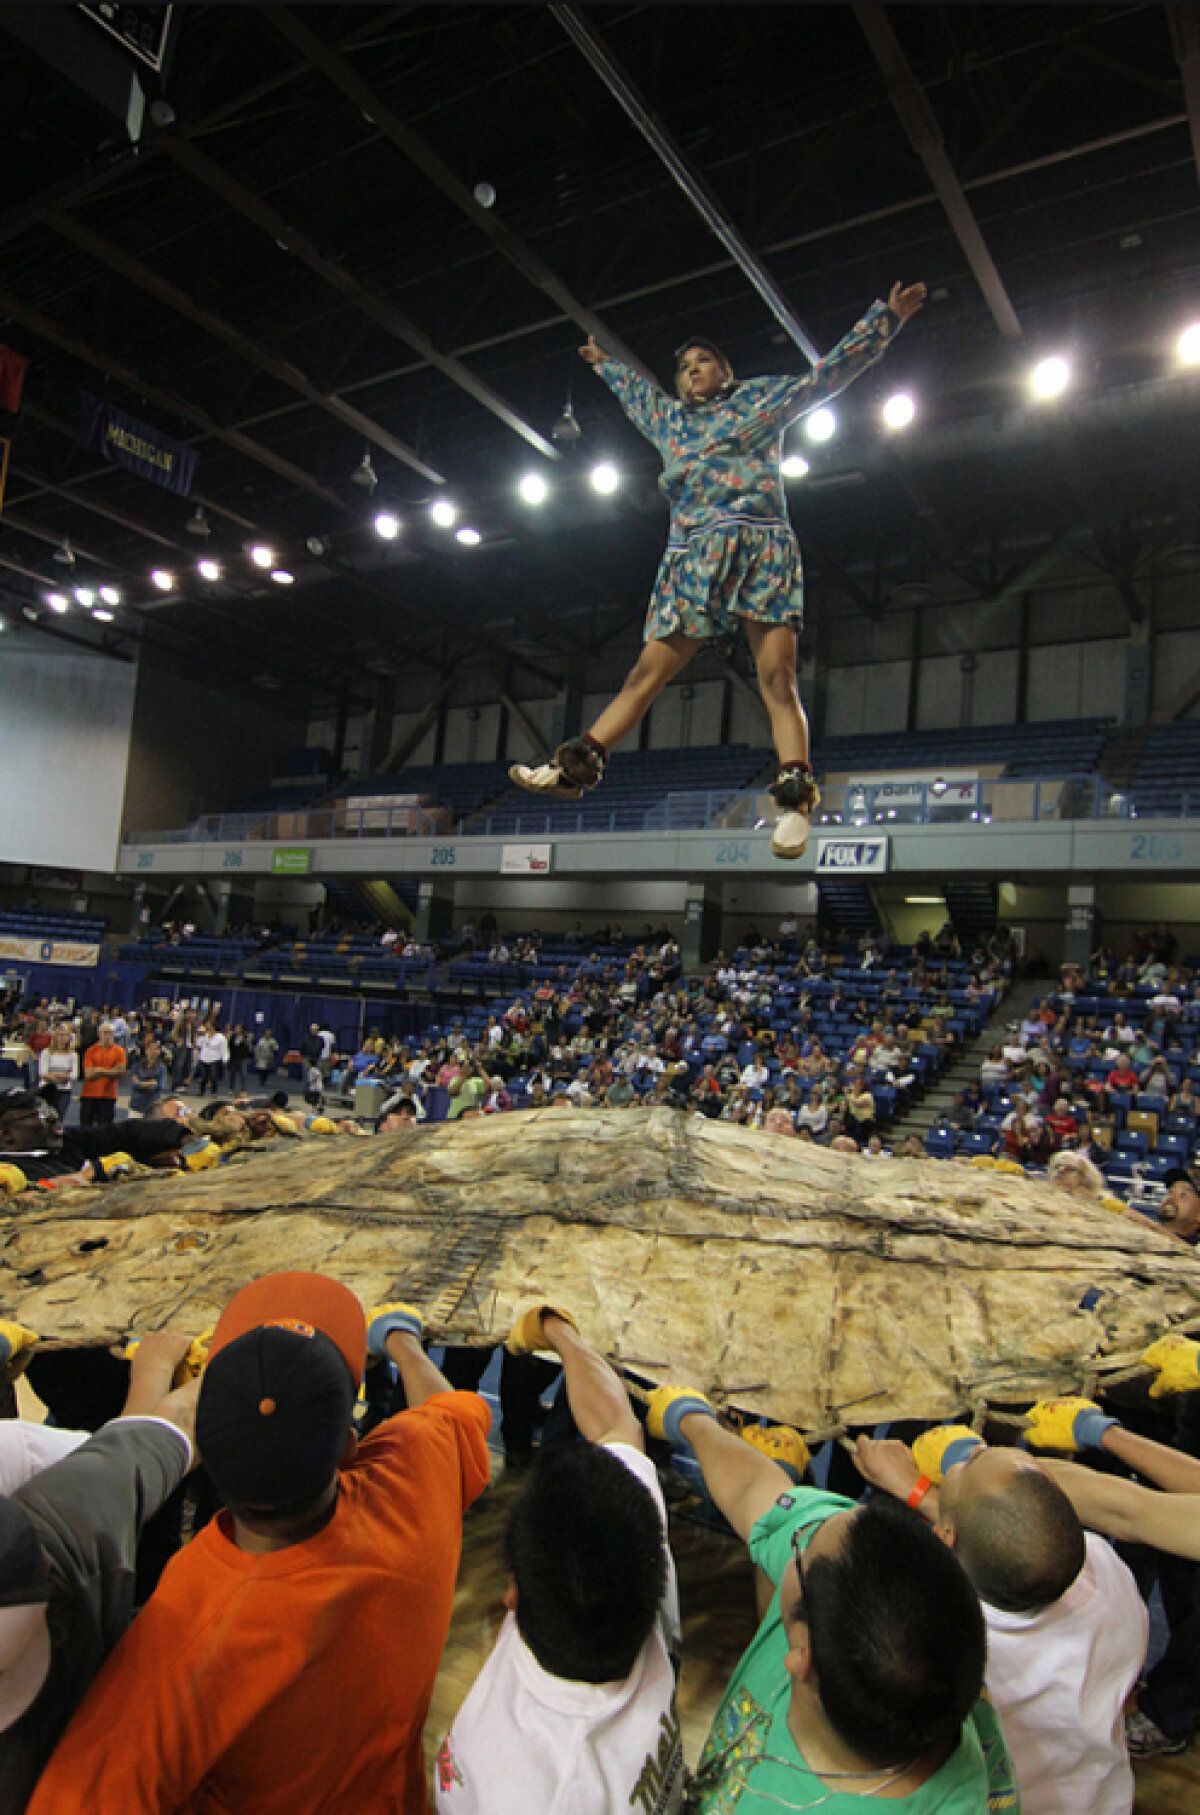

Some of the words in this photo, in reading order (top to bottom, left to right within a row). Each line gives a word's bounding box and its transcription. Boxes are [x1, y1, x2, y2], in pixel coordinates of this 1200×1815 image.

[106, 422, 173, 473] MICHIGAN
[430, 846, 456, 866] 205
[715, 842, 749, 863] 204
[865, 844, 881, 865] 7
